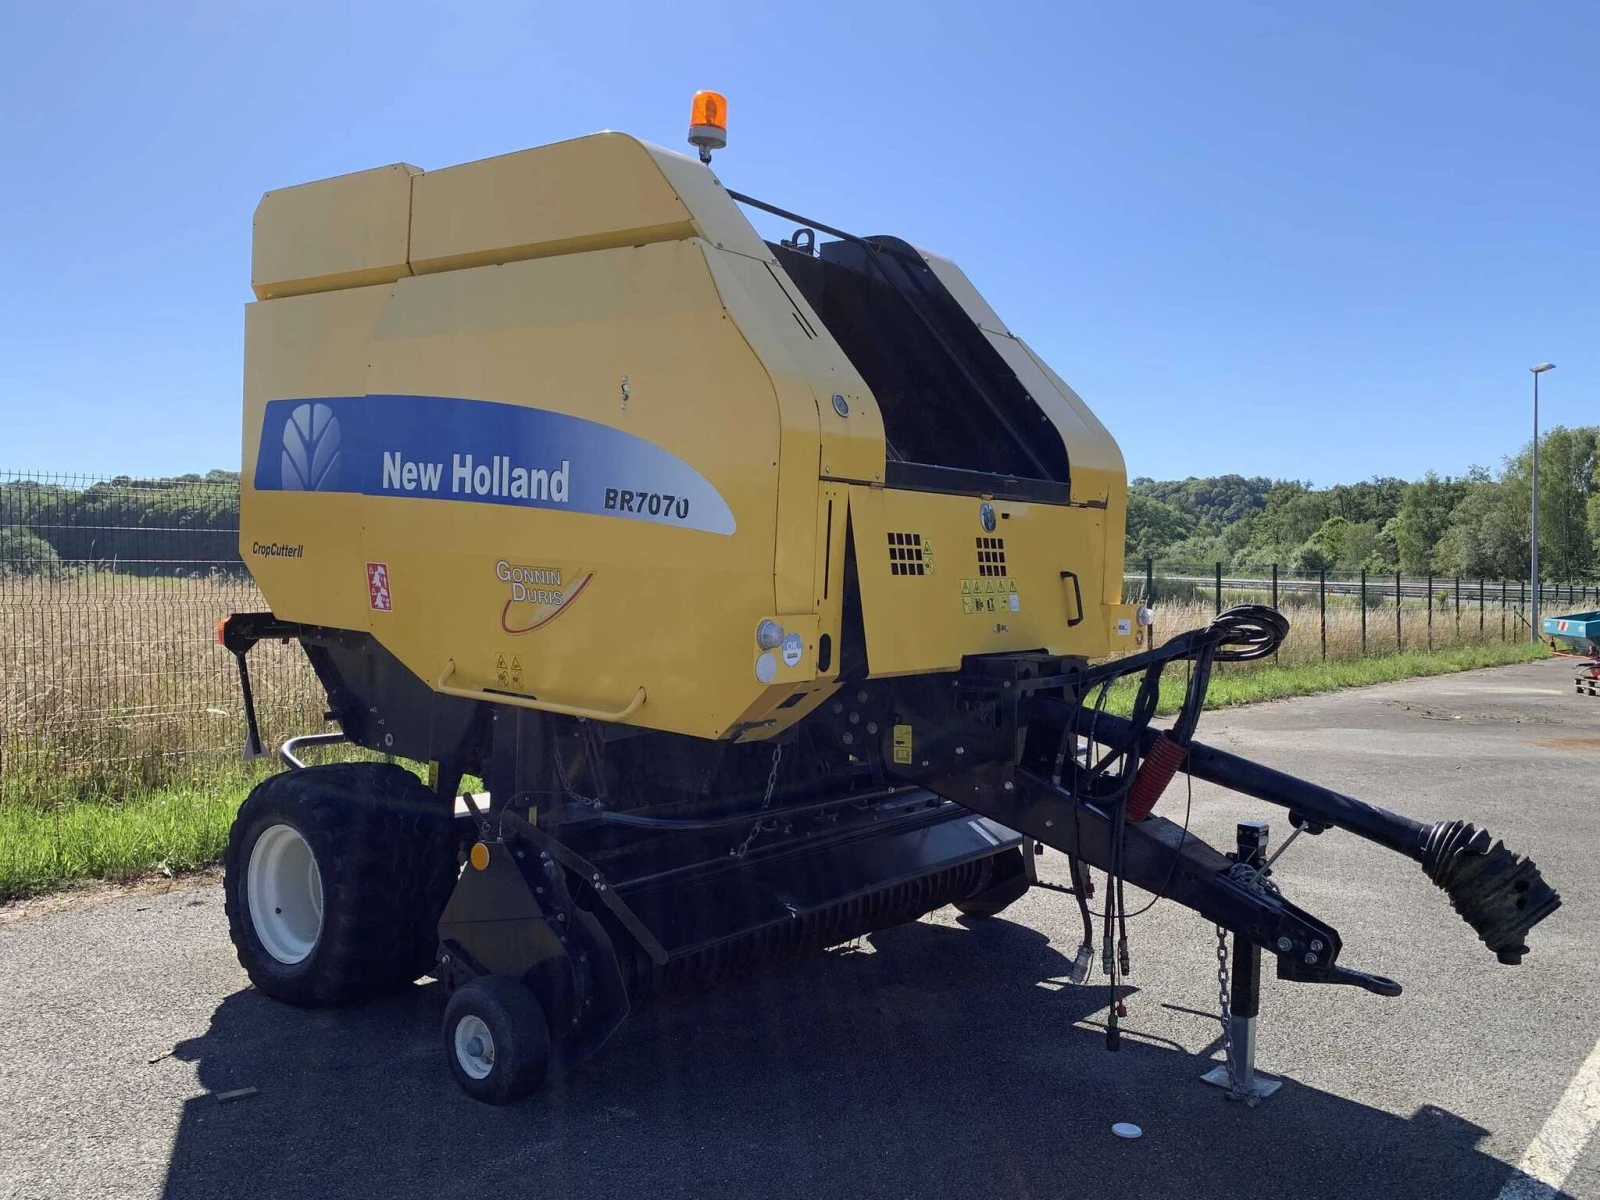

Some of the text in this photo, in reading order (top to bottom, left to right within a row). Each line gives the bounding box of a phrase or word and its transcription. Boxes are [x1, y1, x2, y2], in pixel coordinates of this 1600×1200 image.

[382, 451, 570, 503] New Holland
[604, 487, 689, 519] BR7070
[495, 559, 562, 586] GONNIN
[512, 582, 564, 606] DURIS
